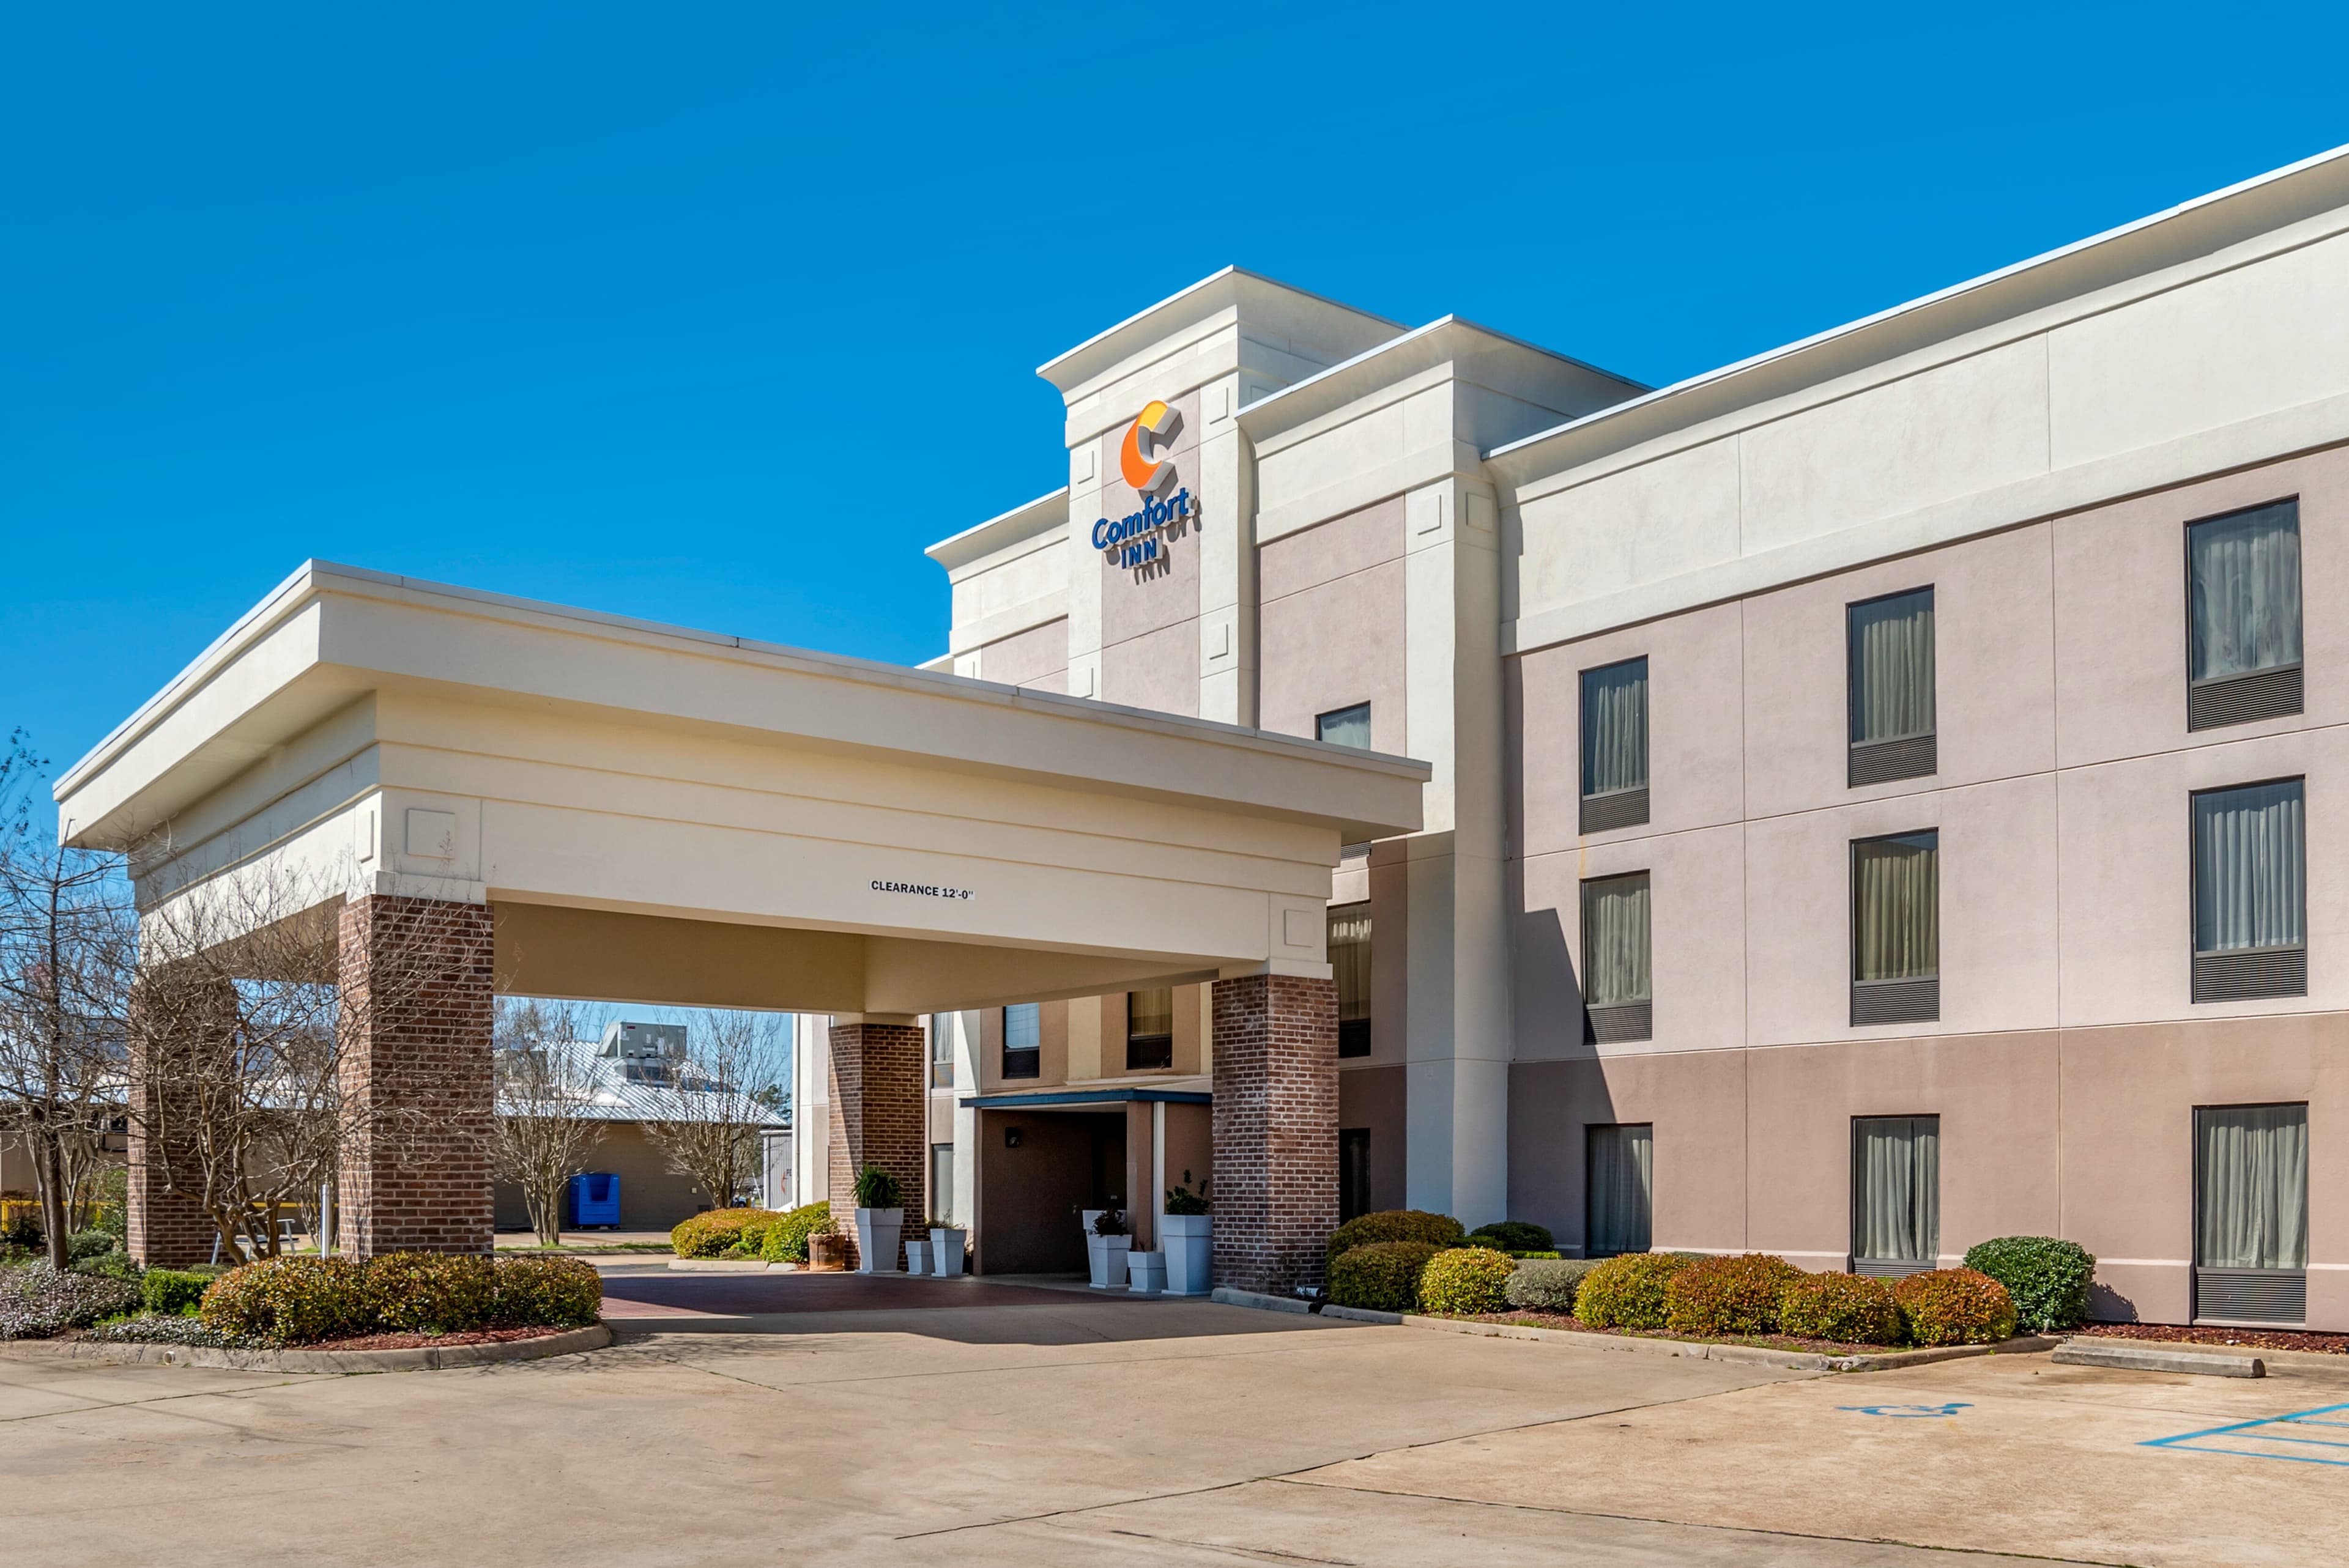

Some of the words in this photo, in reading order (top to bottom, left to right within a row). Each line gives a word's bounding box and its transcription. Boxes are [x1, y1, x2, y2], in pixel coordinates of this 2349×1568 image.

[1091, 487, 1189, 550] Comfort
[1121, 537, 1157, 569] INN
[871, 880, 939, 897] CLEARANCE
